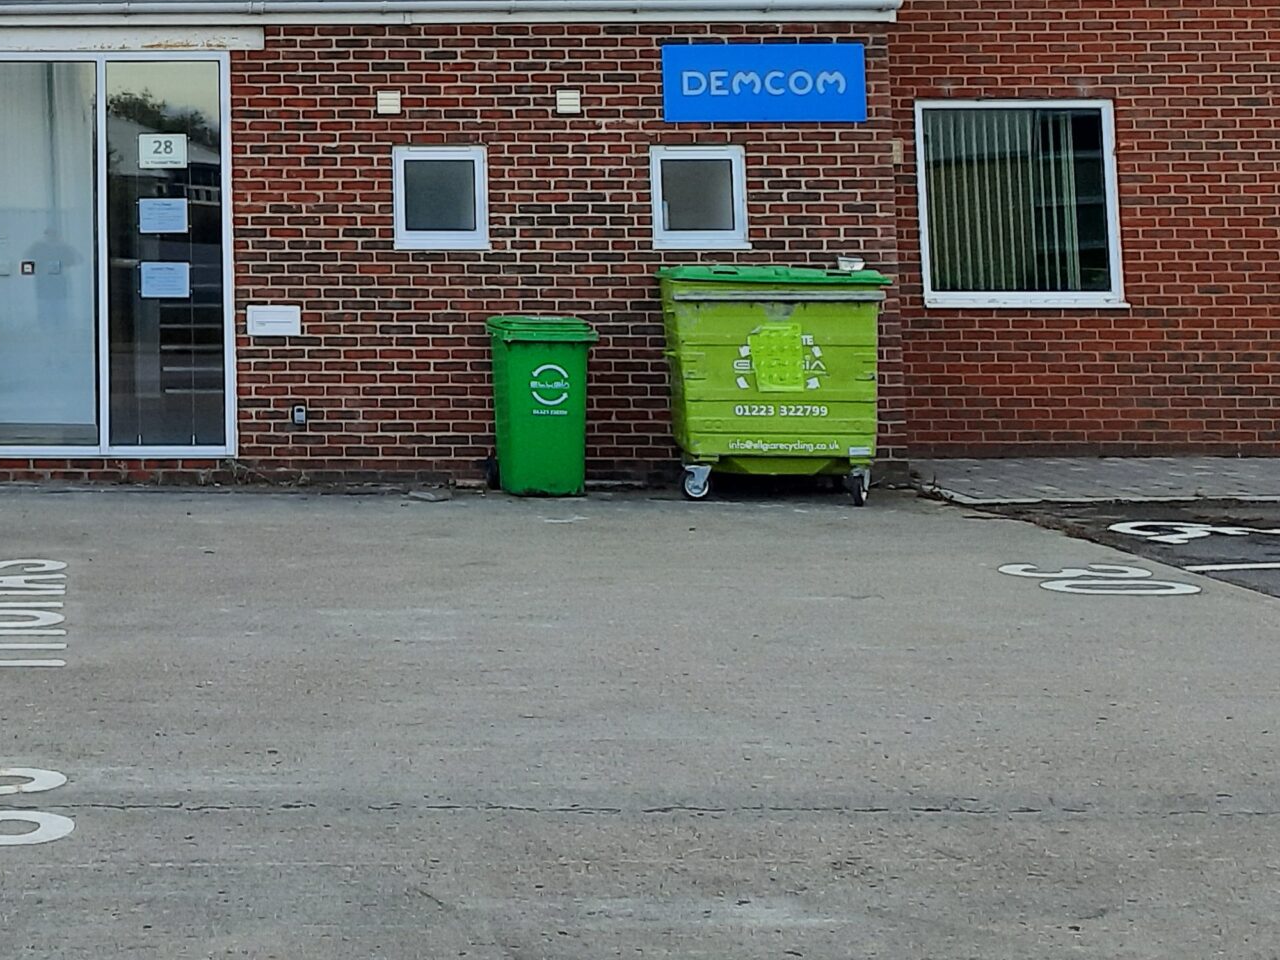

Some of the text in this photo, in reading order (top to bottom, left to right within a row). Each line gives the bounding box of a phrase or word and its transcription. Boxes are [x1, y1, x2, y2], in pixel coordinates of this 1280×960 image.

[681, 70, 847, 96] DEMCOM
[152, 139, 173, 154] 28
[735, 404, 829, 417] 01223 322799
